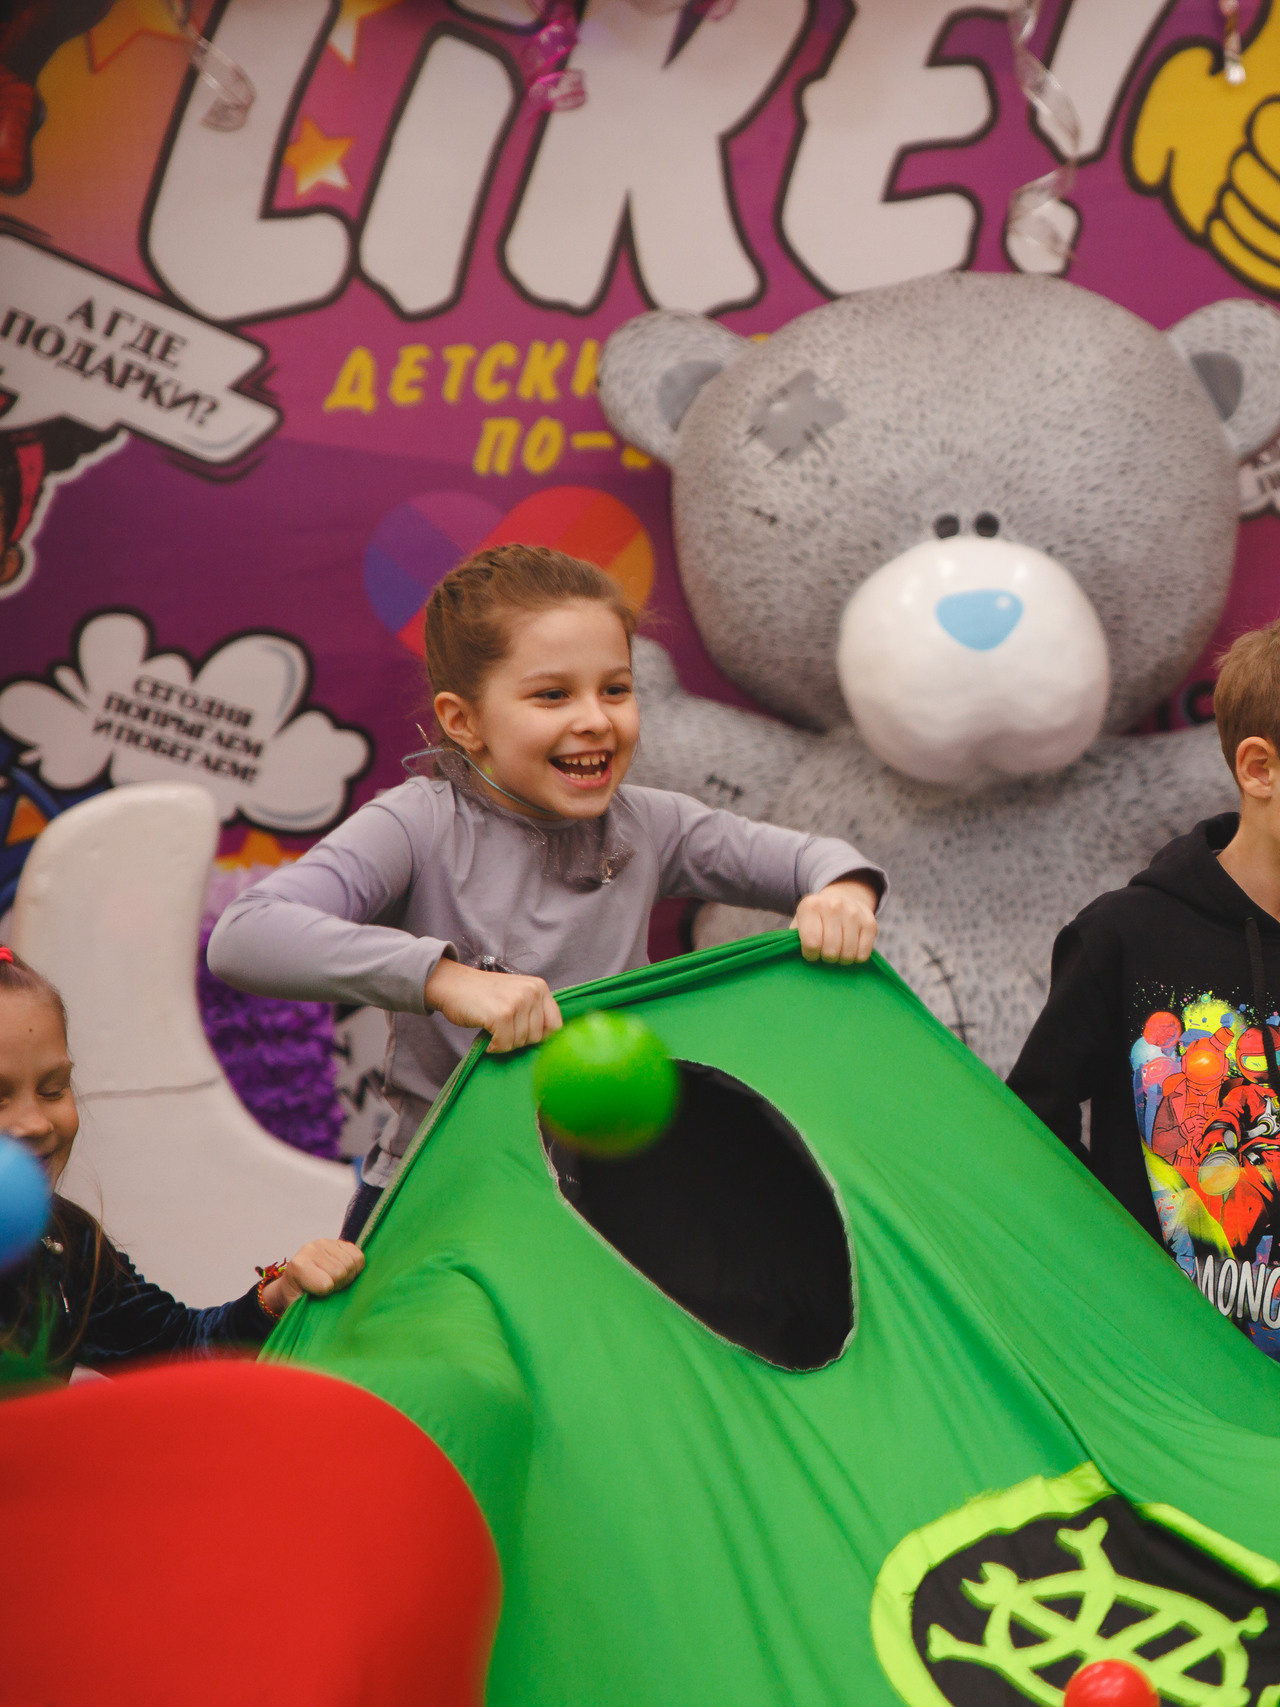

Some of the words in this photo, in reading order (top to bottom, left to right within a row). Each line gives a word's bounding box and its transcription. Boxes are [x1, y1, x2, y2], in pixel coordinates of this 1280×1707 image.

[66, 297, 95, 330] А
[103, 307, 187, 368] ГДЕ
[0, 306, 219, 427] ПОДАРКИ?
[472, 415, 651, 475] ПО-
[133, 675, 253, 727] СЕГОДНЯ
